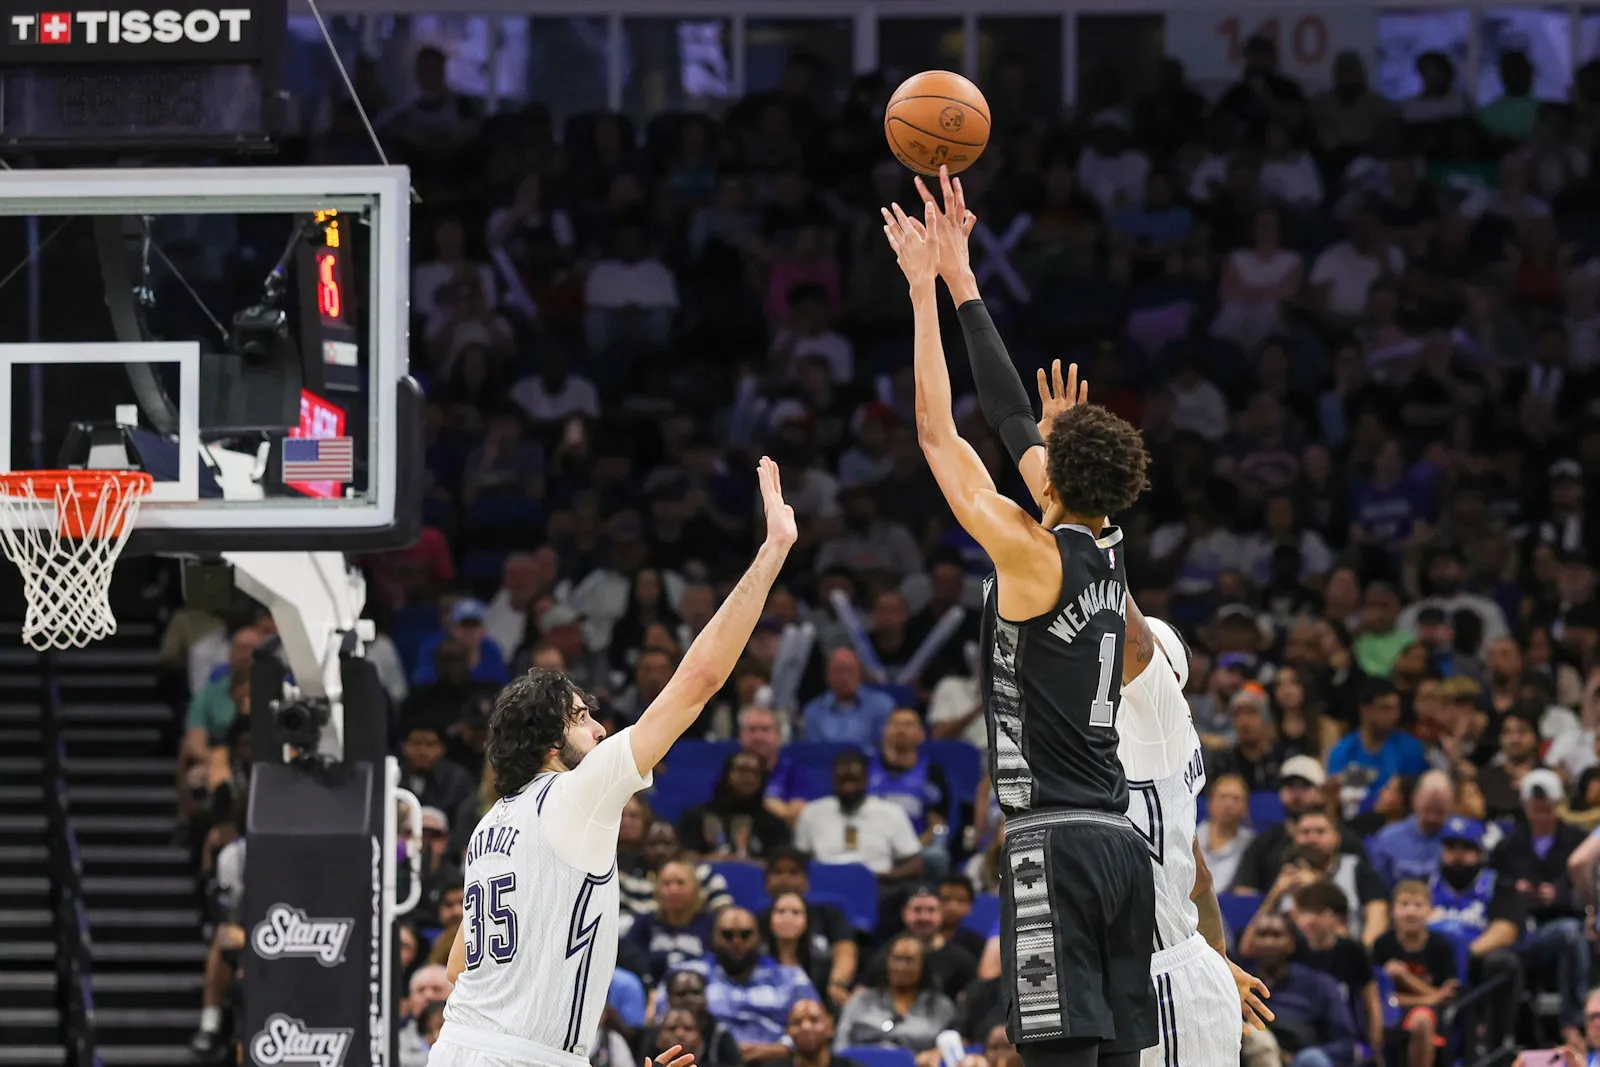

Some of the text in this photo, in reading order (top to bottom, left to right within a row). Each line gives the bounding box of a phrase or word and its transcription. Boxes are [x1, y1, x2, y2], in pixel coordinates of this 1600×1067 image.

[76, 8, 251, 44] TISSOT
[1088, 632, 1117, 728] 1
[467, 826, 520, 867] BITADZE
[255, 906, 350, 964] Starry
[464, 872, 518, 971] 35
